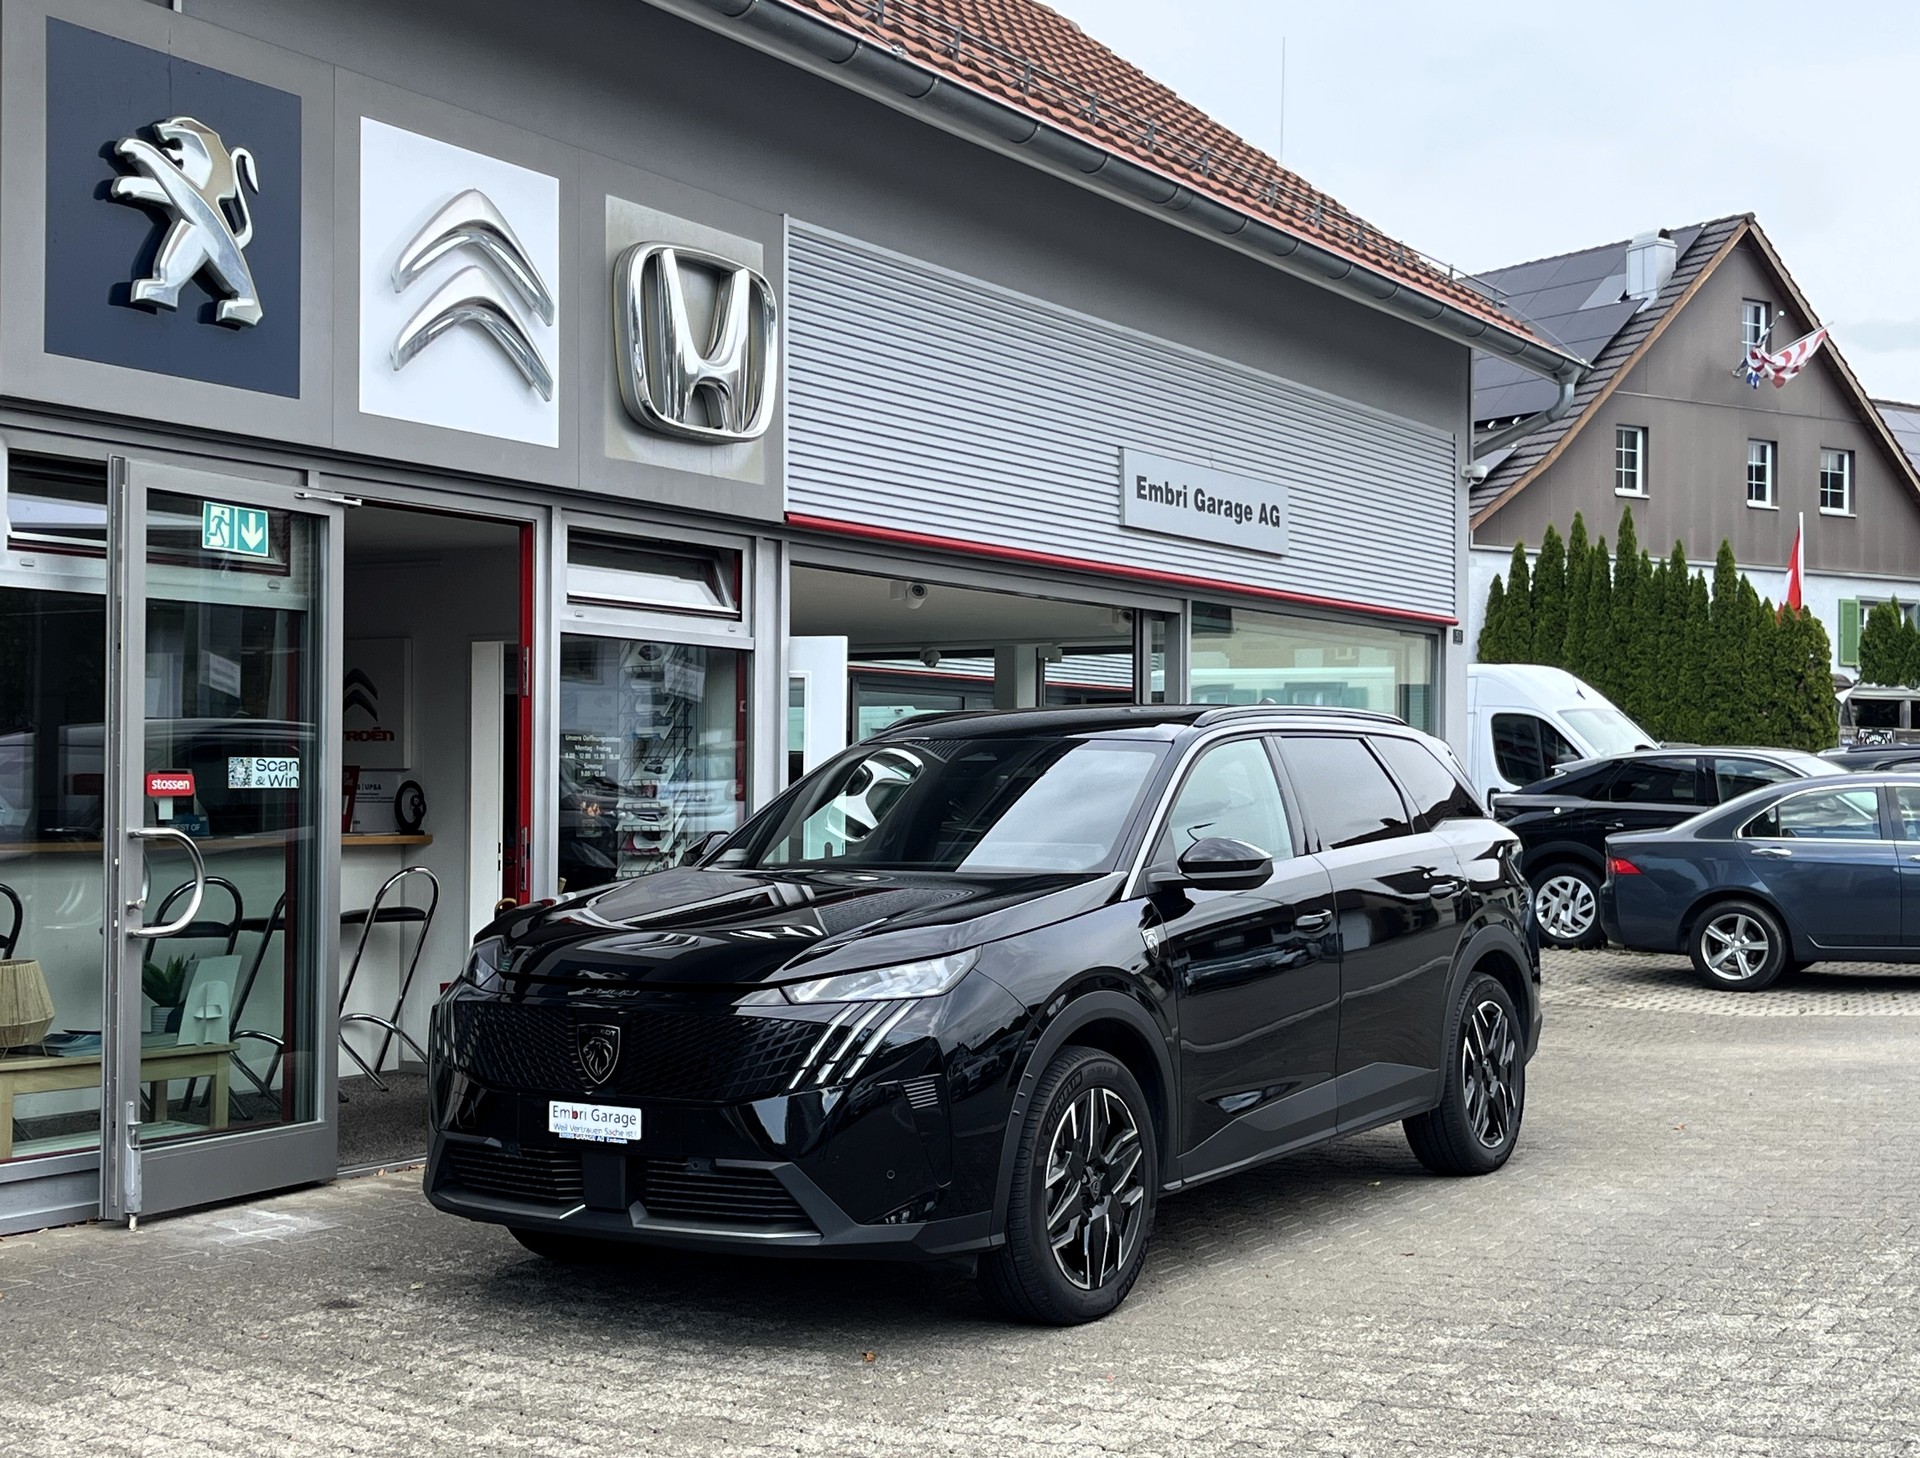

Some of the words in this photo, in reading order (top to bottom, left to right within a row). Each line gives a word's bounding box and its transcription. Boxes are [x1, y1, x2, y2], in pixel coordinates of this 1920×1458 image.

[1136, 475, 1188, 508] Embri
[1194, 488, 1253, 525] Garage
[1258, 503, 1280, 528] AG
[256, 758, 298, 772] Scan
[151, 779, 190, 790] stossen
[255, 777, 265, 786] &
[268, 774, 298, 787] Win
[553, 1105, 587, 1121] Embri
[591, 1109, 637, 1128] Garage
